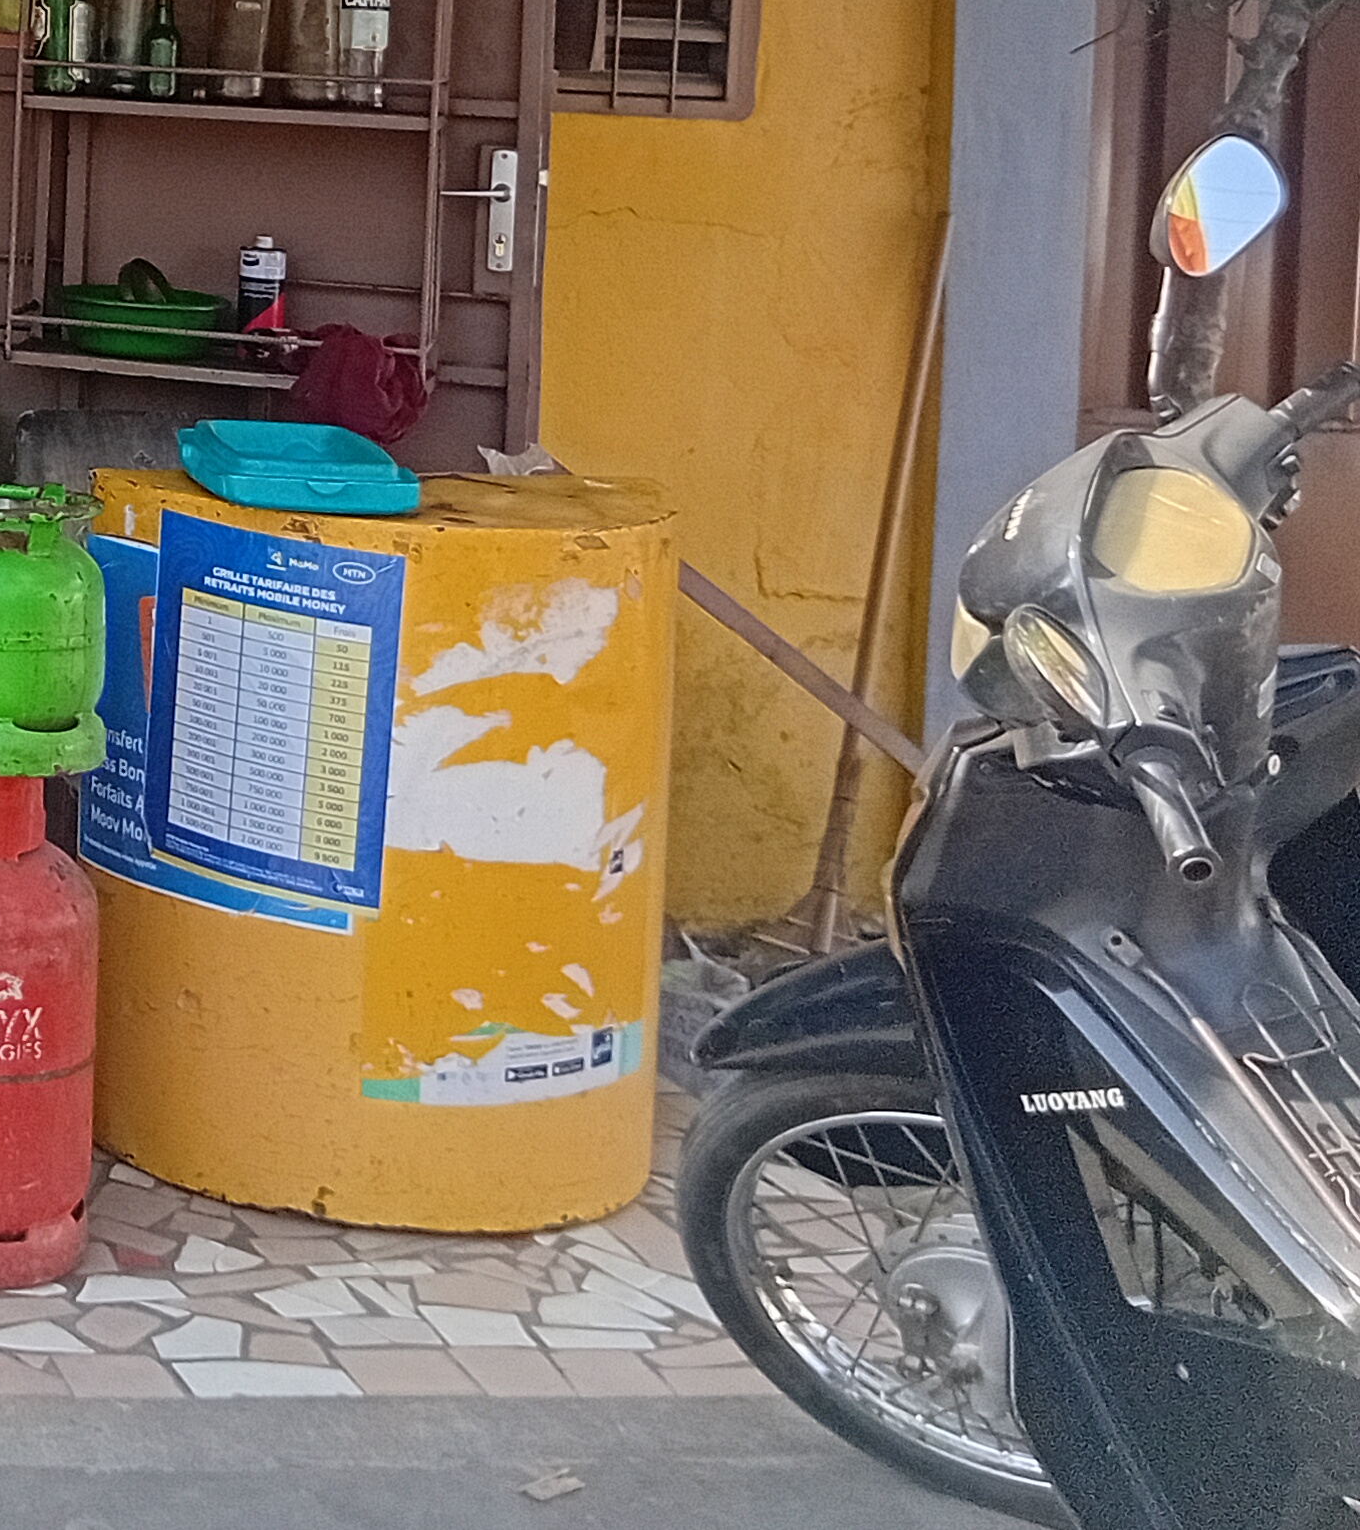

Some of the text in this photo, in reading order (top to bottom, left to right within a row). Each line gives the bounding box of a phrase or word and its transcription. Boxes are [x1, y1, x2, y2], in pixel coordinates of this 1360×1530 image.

[212, 566, 336, 601] GRILLE TARIFAIRE DES
[342, 567, 367, 580] MTN
[204, 576, 347, 615] RETRAITS MOBILE MONEY
[1020, 1086, 1125, 1114] LUOYANG
